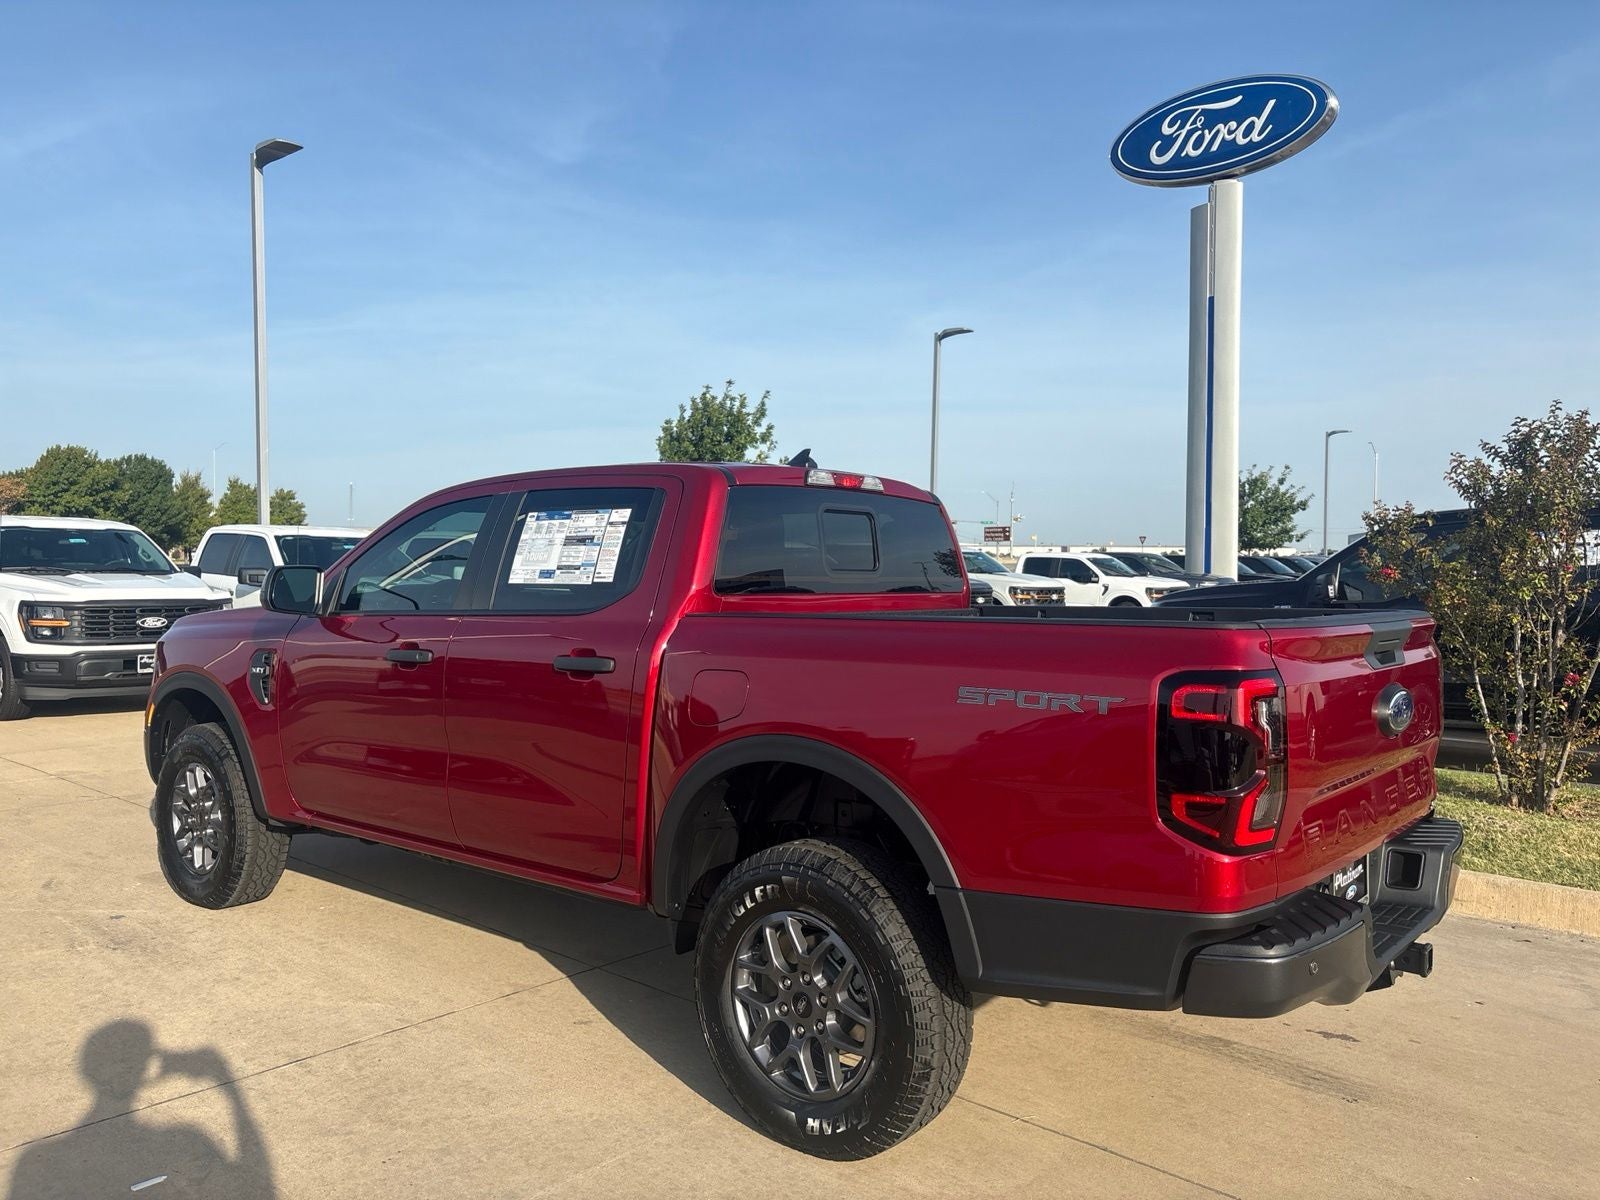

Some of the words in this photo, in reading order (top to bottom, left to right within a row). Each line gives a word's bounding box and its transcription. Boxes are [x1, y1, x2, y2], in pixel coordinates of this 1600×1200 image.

[1150, 95, 1275, 166] Ford
[956, 686, 1127, 716] SPORT
[1302, 765, 1430, 858] RANGER
